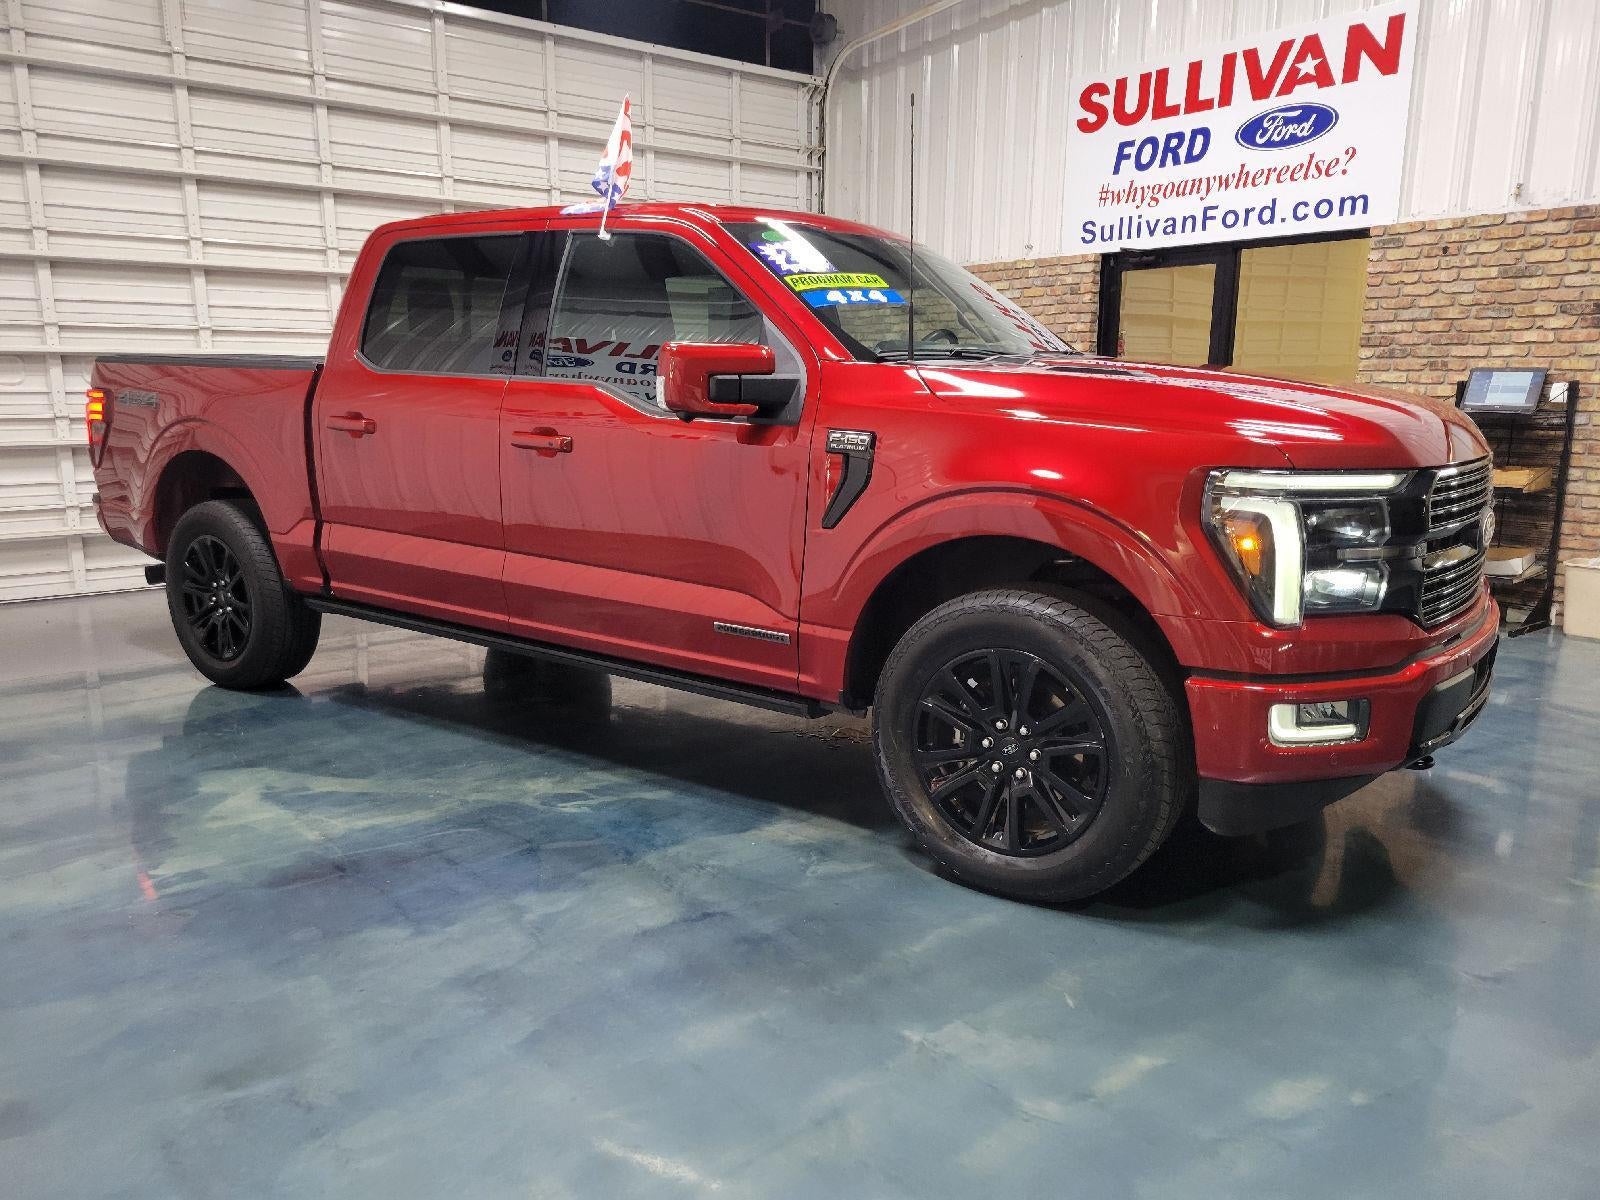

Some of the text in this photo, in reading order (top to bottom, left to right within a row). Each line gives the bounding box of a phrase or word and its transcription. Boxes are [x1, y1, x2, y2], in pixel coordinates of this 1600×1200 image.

[1076, 13, 1406, 134] SULLIVAN
[1255, 110, 1319, 145] Ford
[1112, 126, 1211, 175] FORD
[1098, 146, 1357, 209] #whygoanywhereelse?
[1080, 193, 1370, 244] SullivanFord.com
[791, 275, 881, 287] PROGRAM CAR
[829, 433, 870, 445] F-150
[830, 443, 865, 451] PLATINUM
